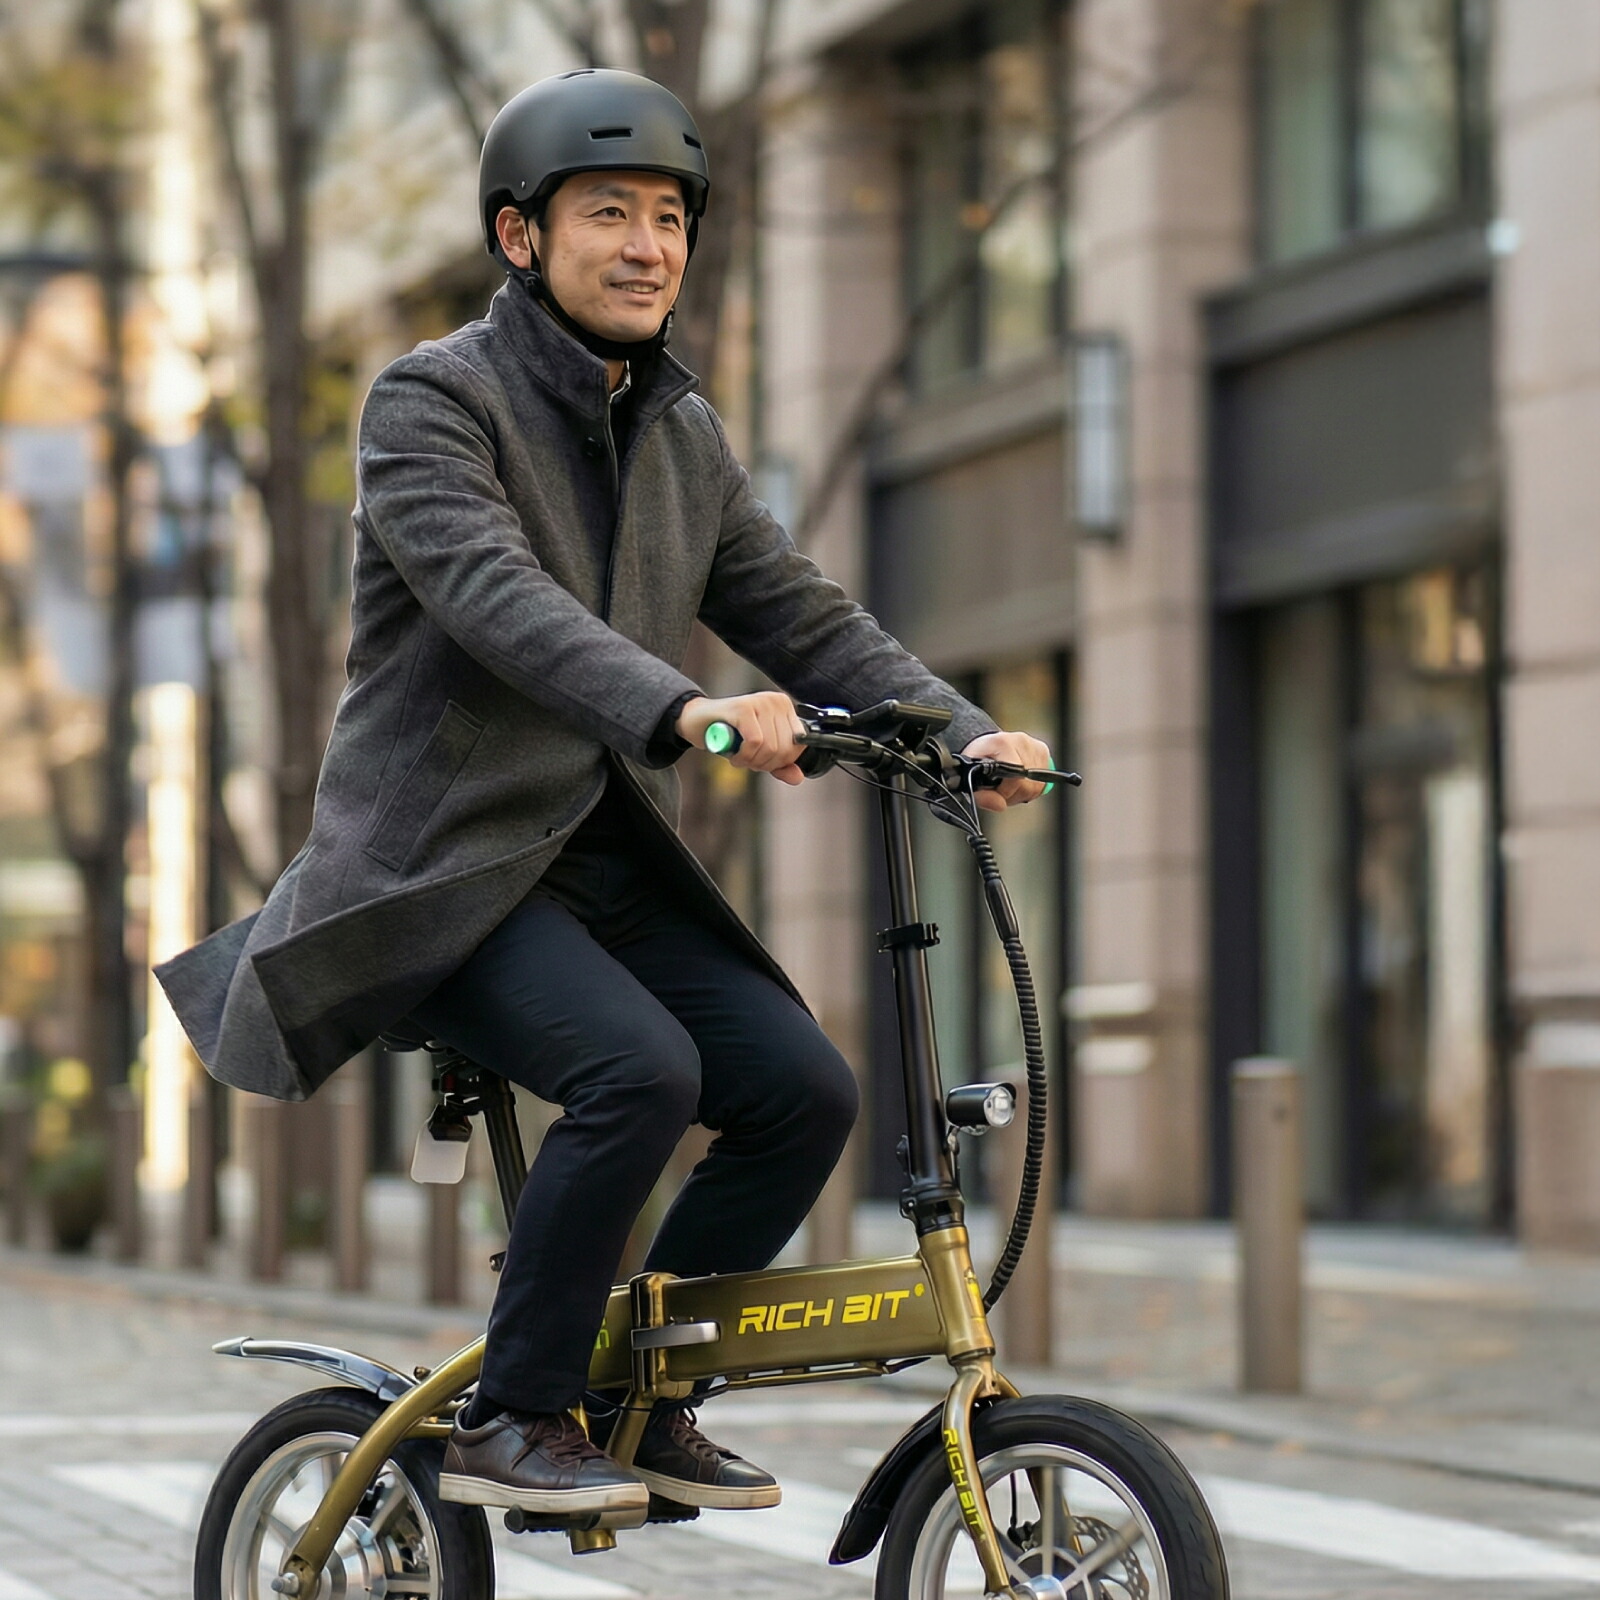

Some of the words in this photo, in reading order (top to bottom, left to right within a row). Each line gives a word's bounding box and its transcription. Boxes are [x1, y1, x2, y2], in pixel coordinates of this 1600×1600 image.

[738, 1300, 834, 1335] RICH
[841, 1289, 911, 1324] BIT
[943, 1428, 969, 1488] RICH
[959, 1490, 986, 1533] BIT
